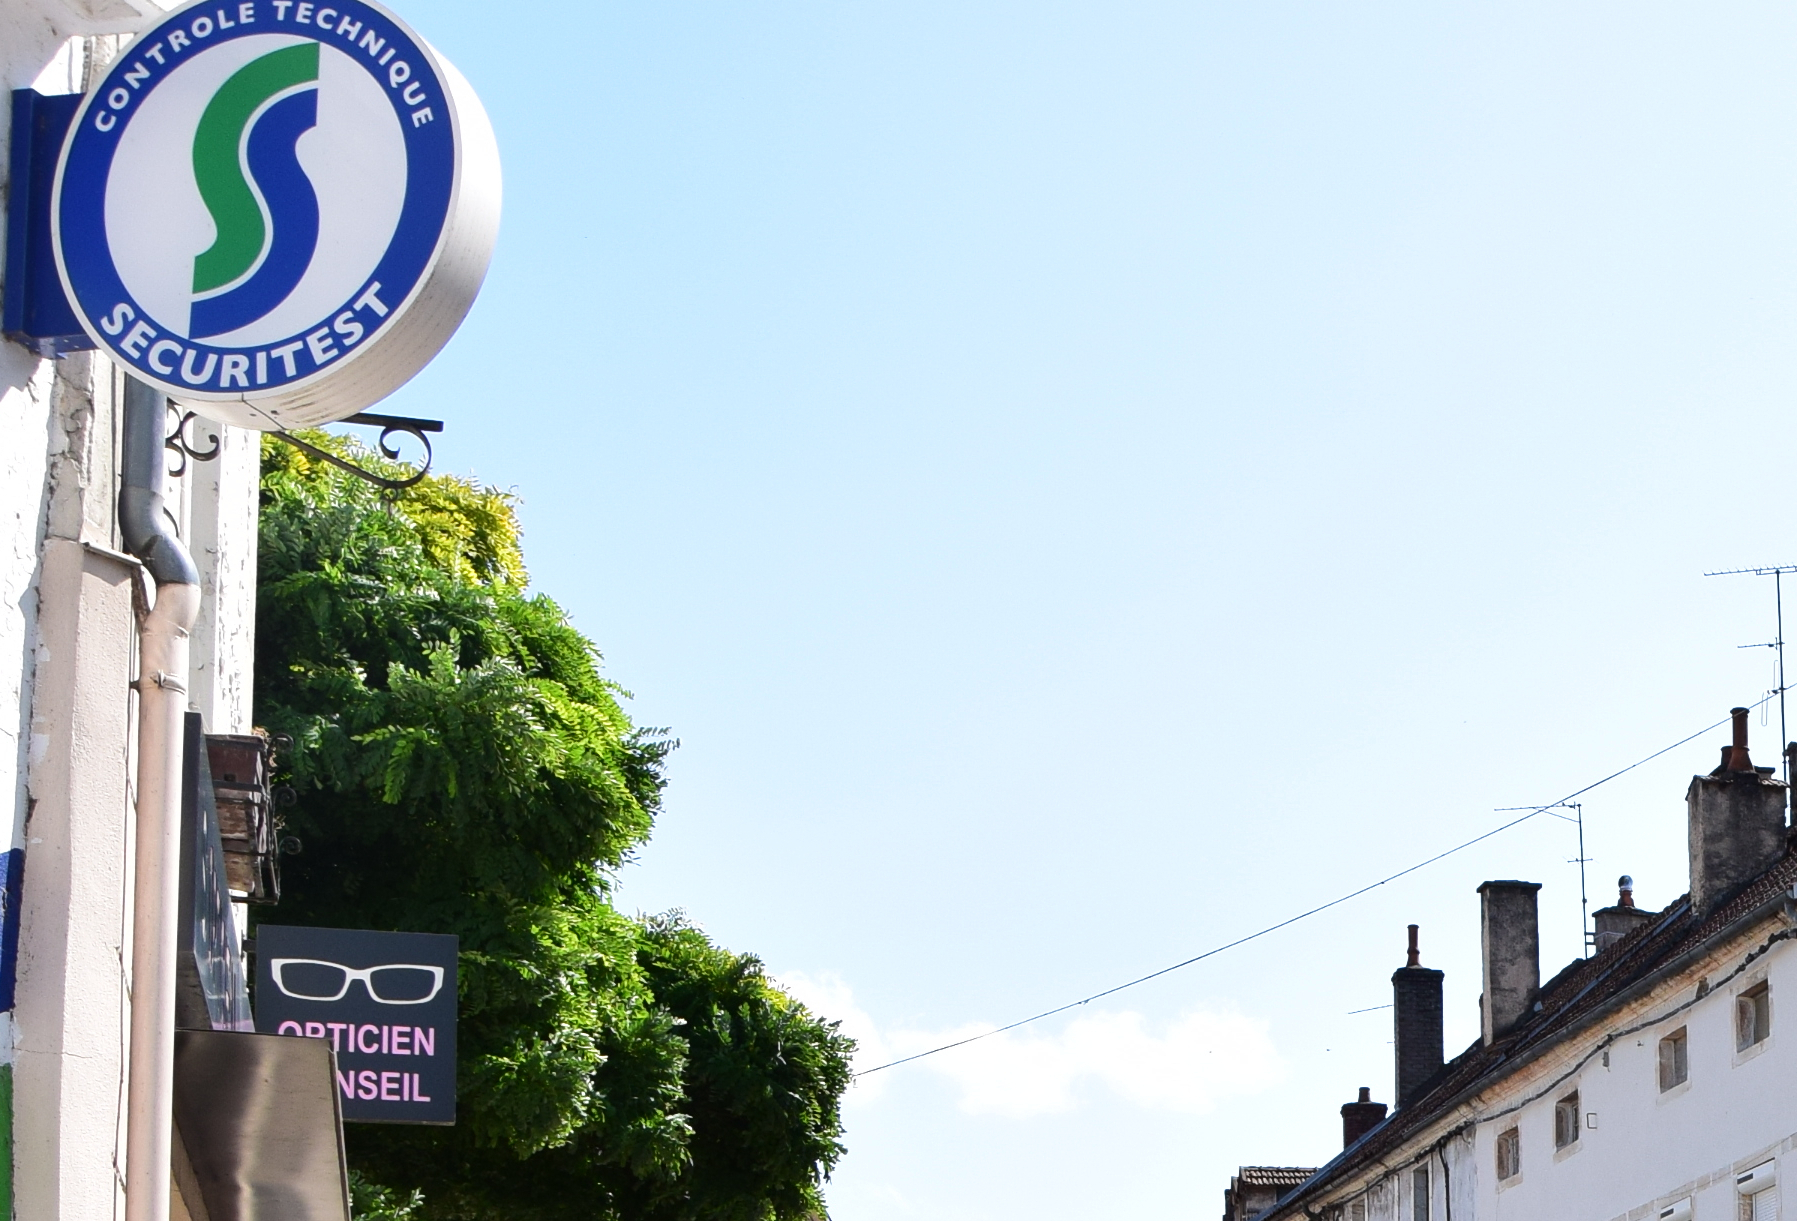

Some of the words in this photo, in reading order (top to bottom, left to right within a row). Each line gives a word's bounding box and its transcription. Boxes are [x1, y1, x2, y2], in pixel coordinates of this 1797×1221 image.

[94, 1, 256, 134] CONTROLE
[272, 0, 434, 129] TECHNIQUE
[100, 281, 390, 388] SECURITEST
[337, 1070, 431, 1102] NSEIL
